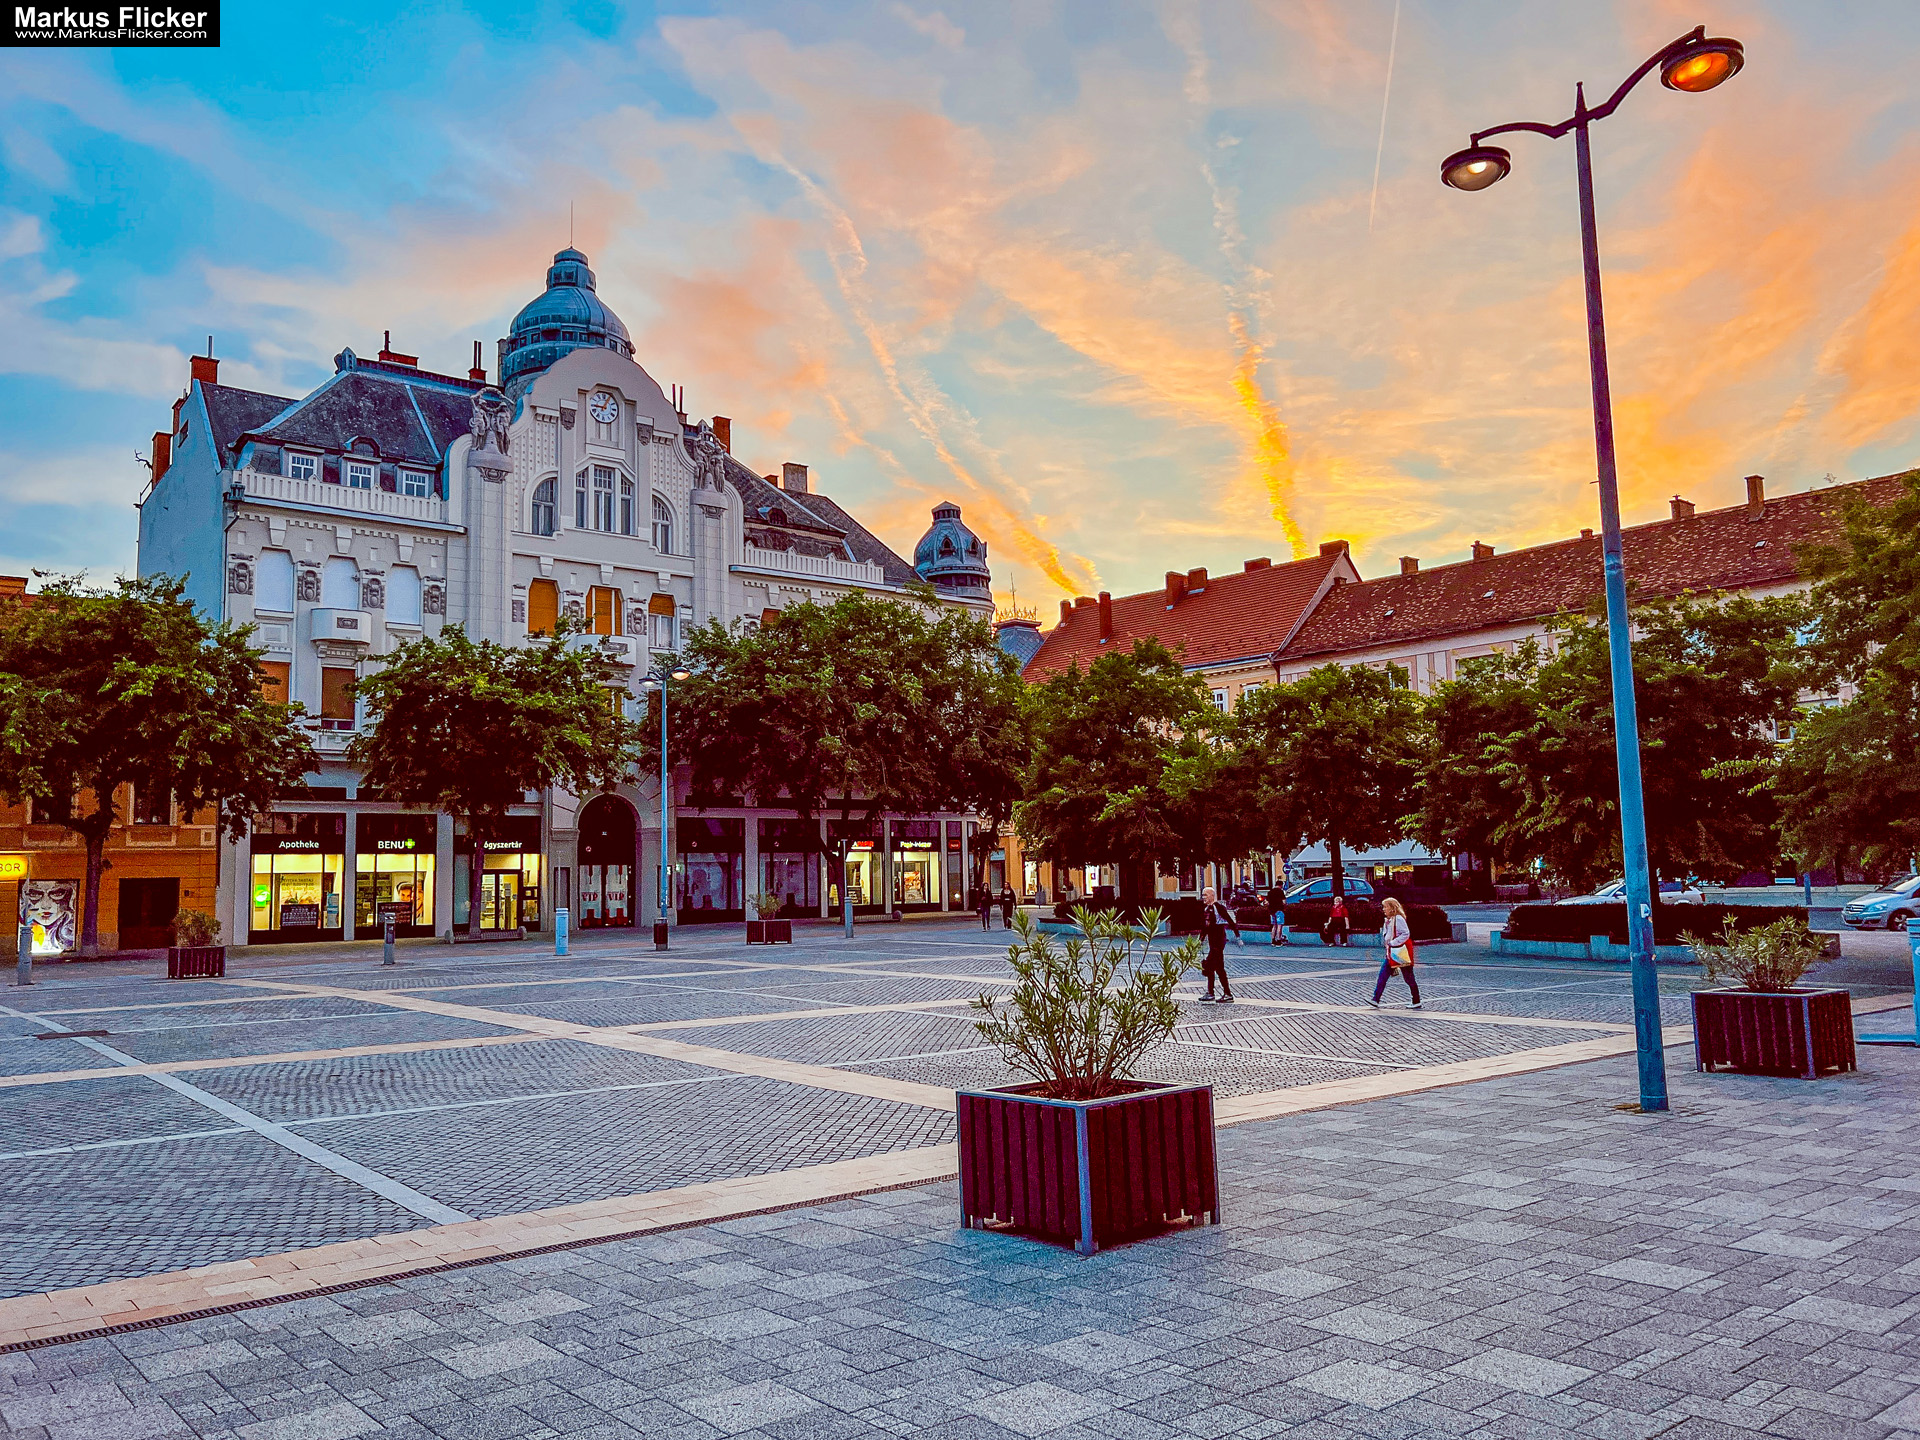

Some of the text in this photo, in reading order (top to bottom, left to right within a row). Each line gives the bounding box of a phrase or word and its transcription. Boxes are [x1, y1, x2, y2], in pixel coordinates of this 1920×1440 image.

[279, 840, 320, 849] Apotheke
[377, 840, 405, 849] BENU
[474, 840, 523, 850] ógyszertár
[581, 891, 598, 902] VIP
[607, 891, 625, 901] VIP
